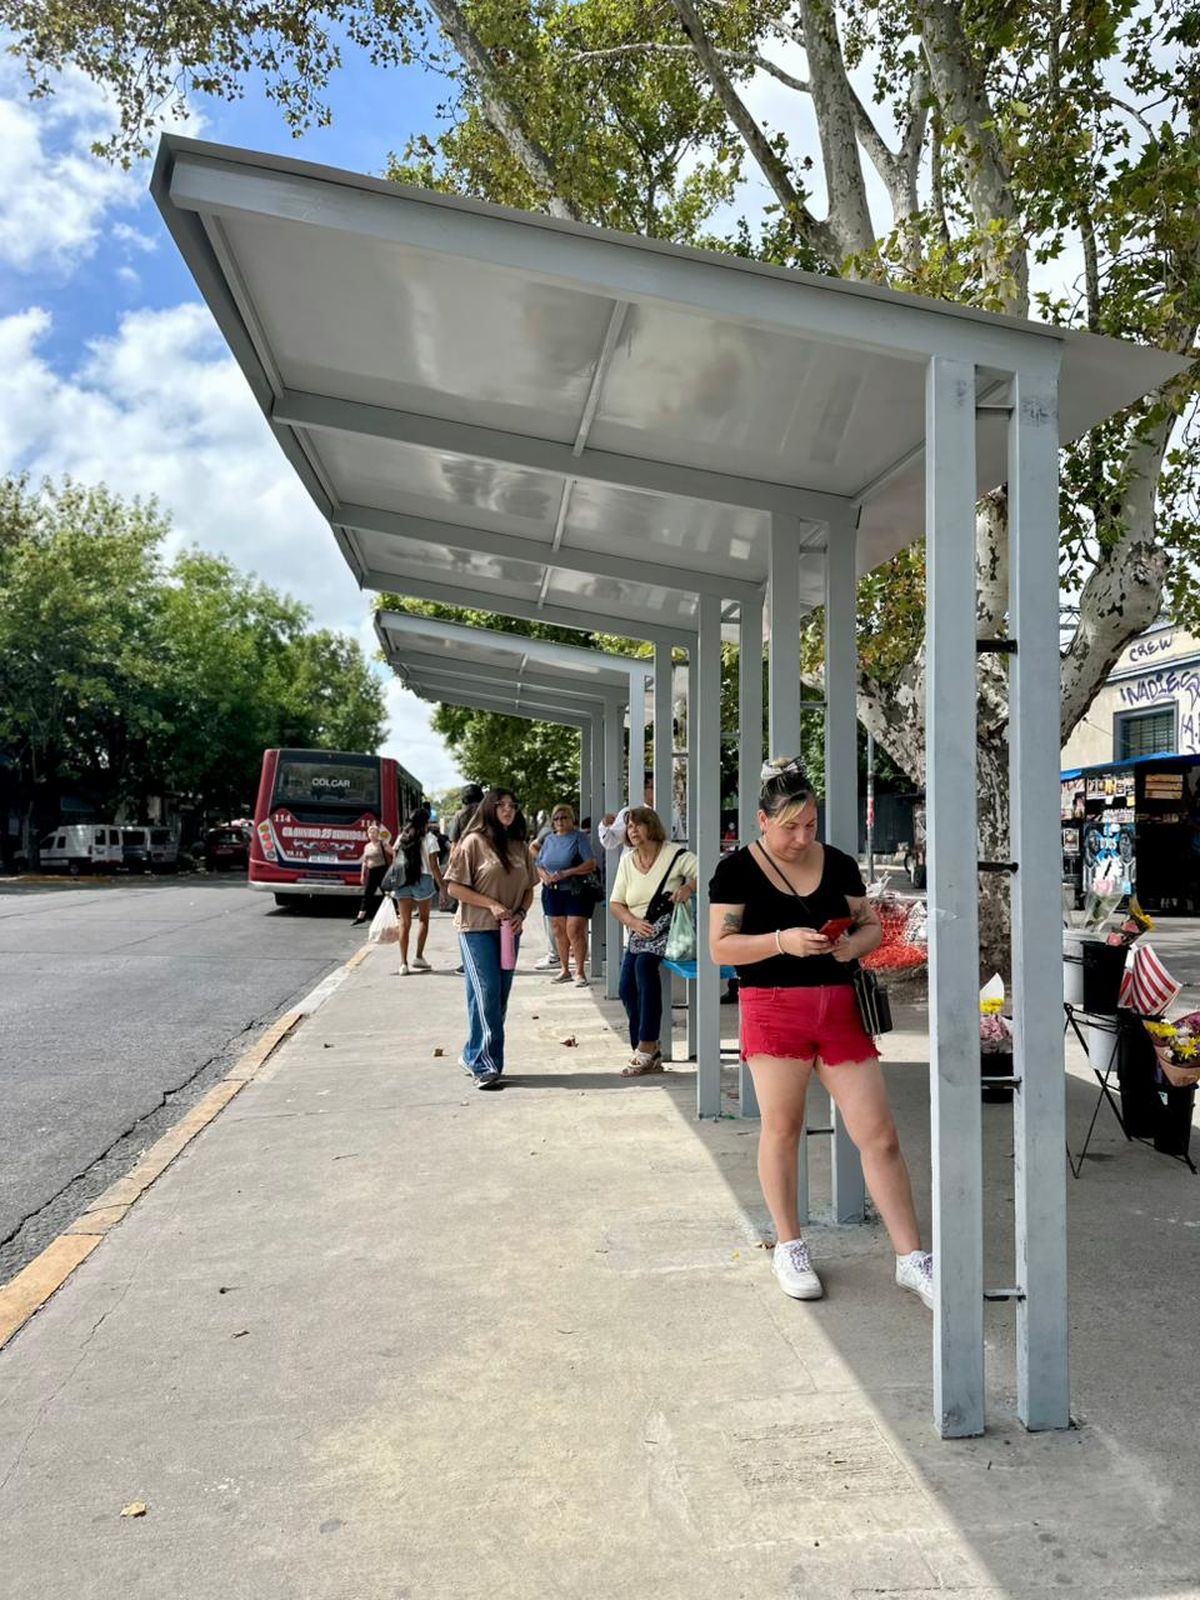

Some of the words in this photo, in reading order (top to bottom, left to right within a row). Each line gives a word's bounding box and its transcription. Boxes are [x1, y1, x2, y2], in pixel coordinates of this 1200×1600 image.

[1129, 634, 1172, 661] CREW
[311, 778, 351, 788] COLCAR
[275, 814, 291, 822] 114
